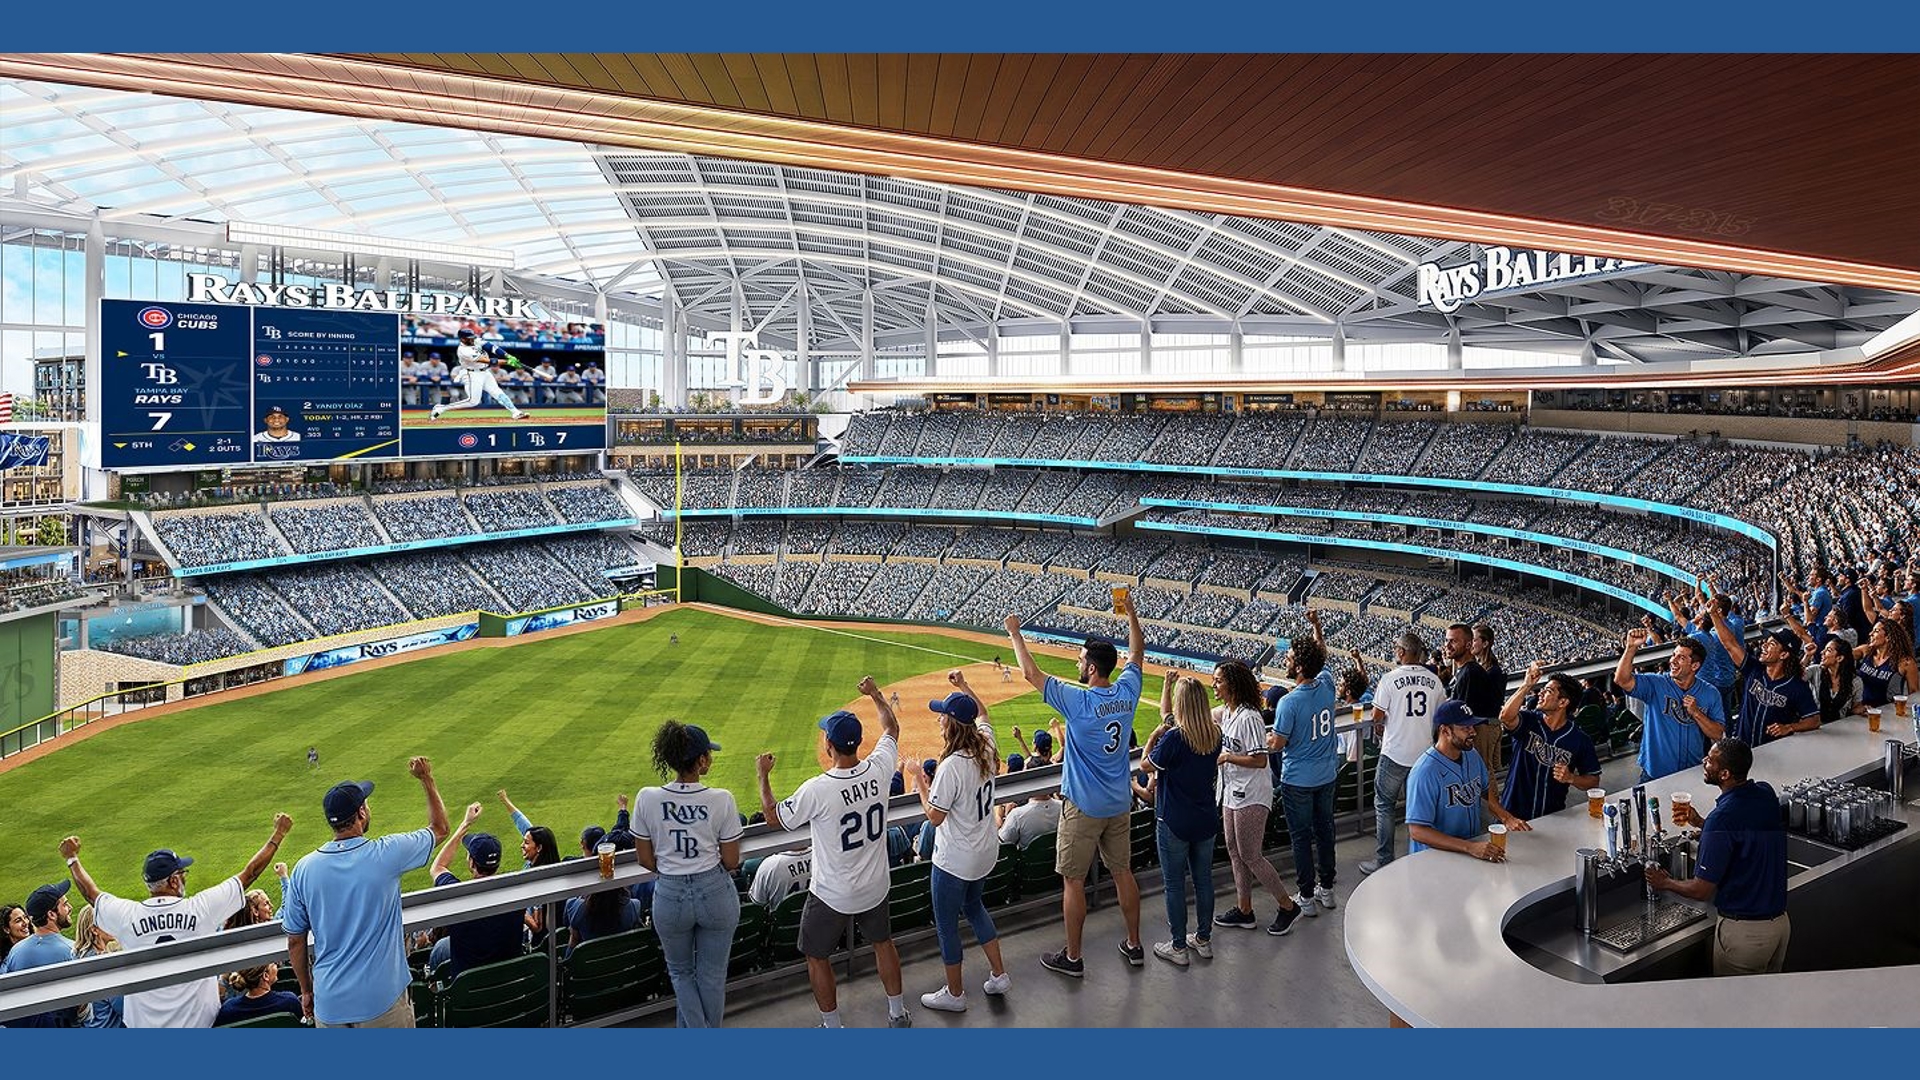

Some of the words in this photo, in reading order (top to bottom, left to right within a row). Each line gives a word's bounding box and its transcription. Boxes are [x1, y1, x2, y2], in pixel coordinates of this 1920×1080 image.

[187, 273, 310, 308] RAYS
[322, 283, 539, 319] BALLPARK
[1417, 261, 1480, 313] RAYS
[177, 320, 218, 329] CUBS
[261, 325, 282, 340] TB
[149, 332, 165, 351] 1
[141, 362, 178, 385] TB
[704, 331, 787, 404] TB
[134, 395, 182, 404] RAYS
[303, 402, 312, 410] 2
[148, 412, 172, 430] 7
[488, 434, 496, 447] 1
[527, 432, 545, 447] TB
[556, 432, 567, 444] 7
[1562, 538, 1578, 548] TAMPA
[1578, 542, 1588, 550] BAY
[1588, 543, 1600, 552] RAYS
[183, 568, 203, 576] TAMPA
[572, 606, 608, 620] RAYS
[359, 642, 398, 659] RAYS
[1394, 676, 1436, 690] CRAWFORD
[1749, 678, 1788, 708] RAYS
[1094, 700, 1132, 719] LONGORIA
[1406, 691, 1427, 717] 13
[1310, 708, 1330, 742] 18
[1104, 720, 1122, 755] 3
[1525, 730, 1572, 768] RAYS
[840, 779, 879, 806] RAYS
[976, 780, 993, 822] 12
[660, 801, 709, 825] RAYS
[840, 802, 884, 852] 20
[668, 829, 700, 859] TB
[132, 913, 197, 937] LONGORIA
